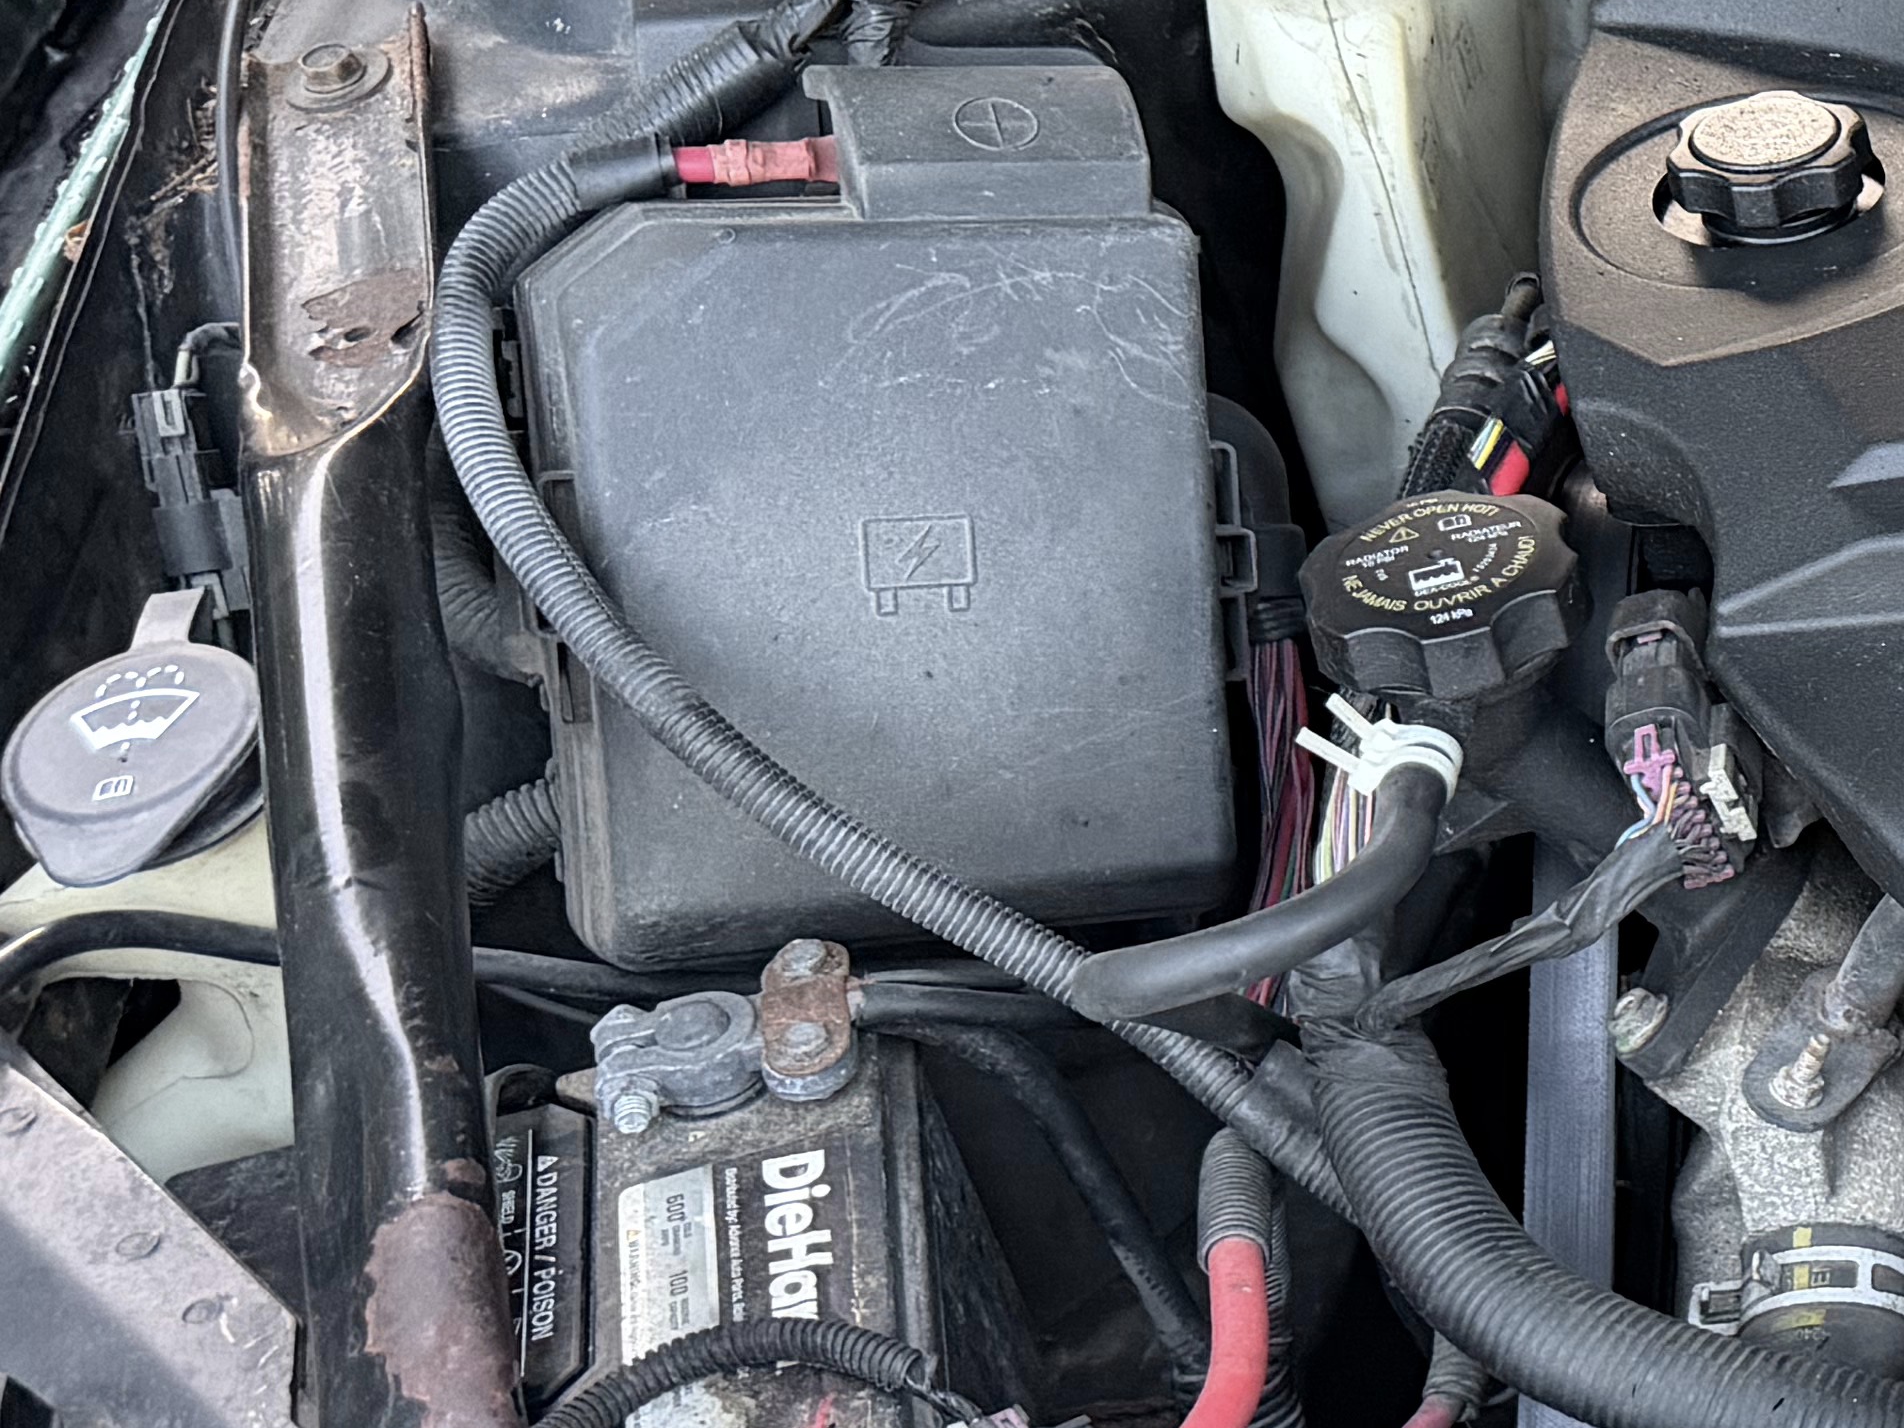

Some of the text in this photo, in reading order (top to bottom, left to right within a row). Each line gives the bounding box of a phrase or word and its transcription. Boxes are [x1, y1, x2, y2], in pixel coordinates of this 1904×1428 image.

[1360, 513, 1413, 542] NEVER
[1413, 503, 1459, 517] OPEN
[1451, 521, 1522, 541] RADIATEUR
[1345, 545, 1409, 567] RADIATOR
[1342, 575, 1363, 592] NE
[1352, 588, 1407, 611] JAMAIS
[1413, 585, 1492, 611] OUVRIR
[1430, 608, 1473, 625] 124 kPa
[724, 1168, 738, 1208] Distributed
[500, 1190, 516, 1224] SHIELD
[534, 1172, 557, 1250] DANGER
[665, 1194, 686, 1222] 600
[727, 1225, 742, 1257] Advance
[761, 1150, 833, 1320] DieHar
[730, 1259, 743, 1277] Auto
[668, 1270, 689, 1296] 100
[531, 1269, 555, 1340] POISON
